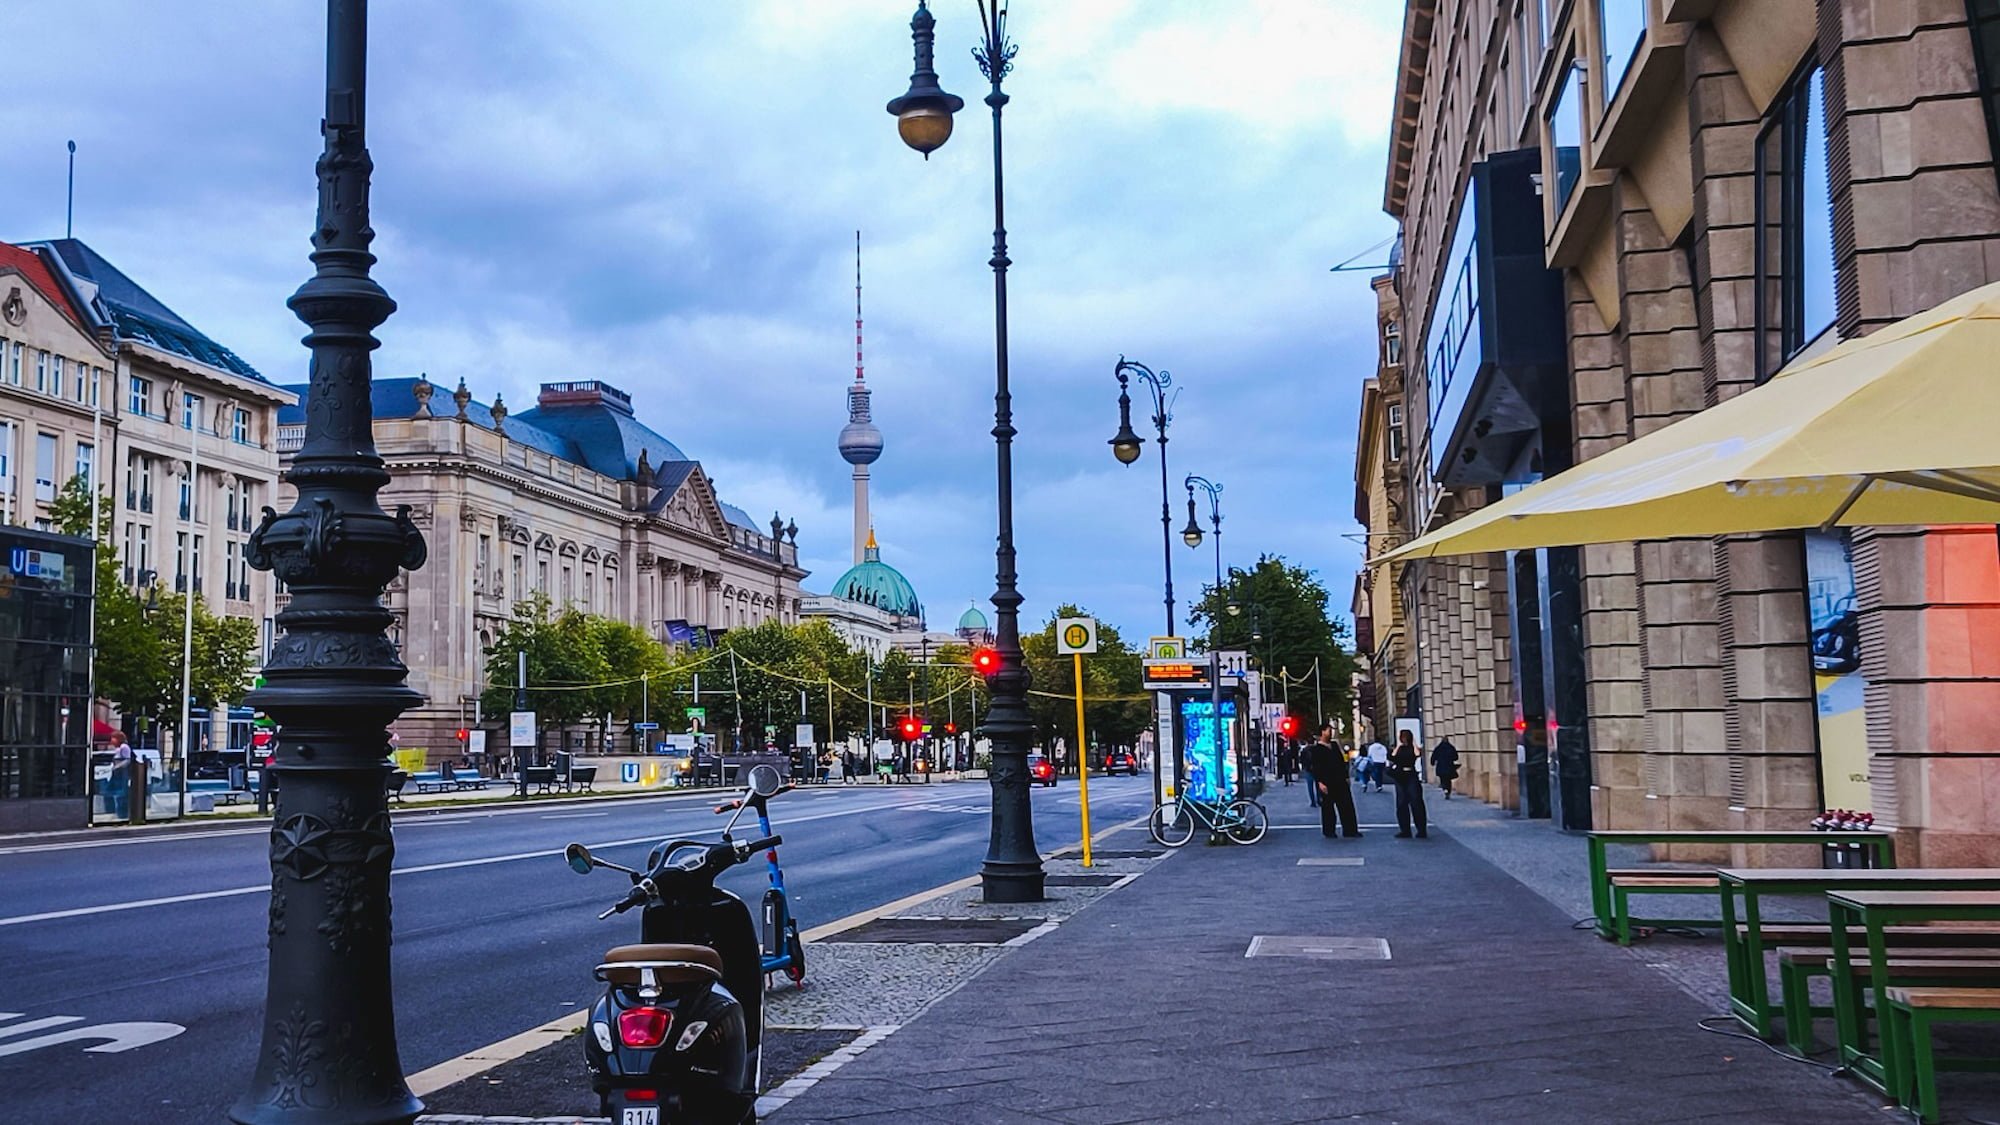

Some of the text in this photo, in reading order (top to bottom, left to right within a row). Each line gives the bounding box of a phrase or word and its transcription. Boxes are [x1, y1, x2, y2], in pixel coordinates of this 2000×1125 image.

[13, 549, 24, 572] U
[624, 764, 639, 782] U
[626, 1110, 654, 1125] 314
